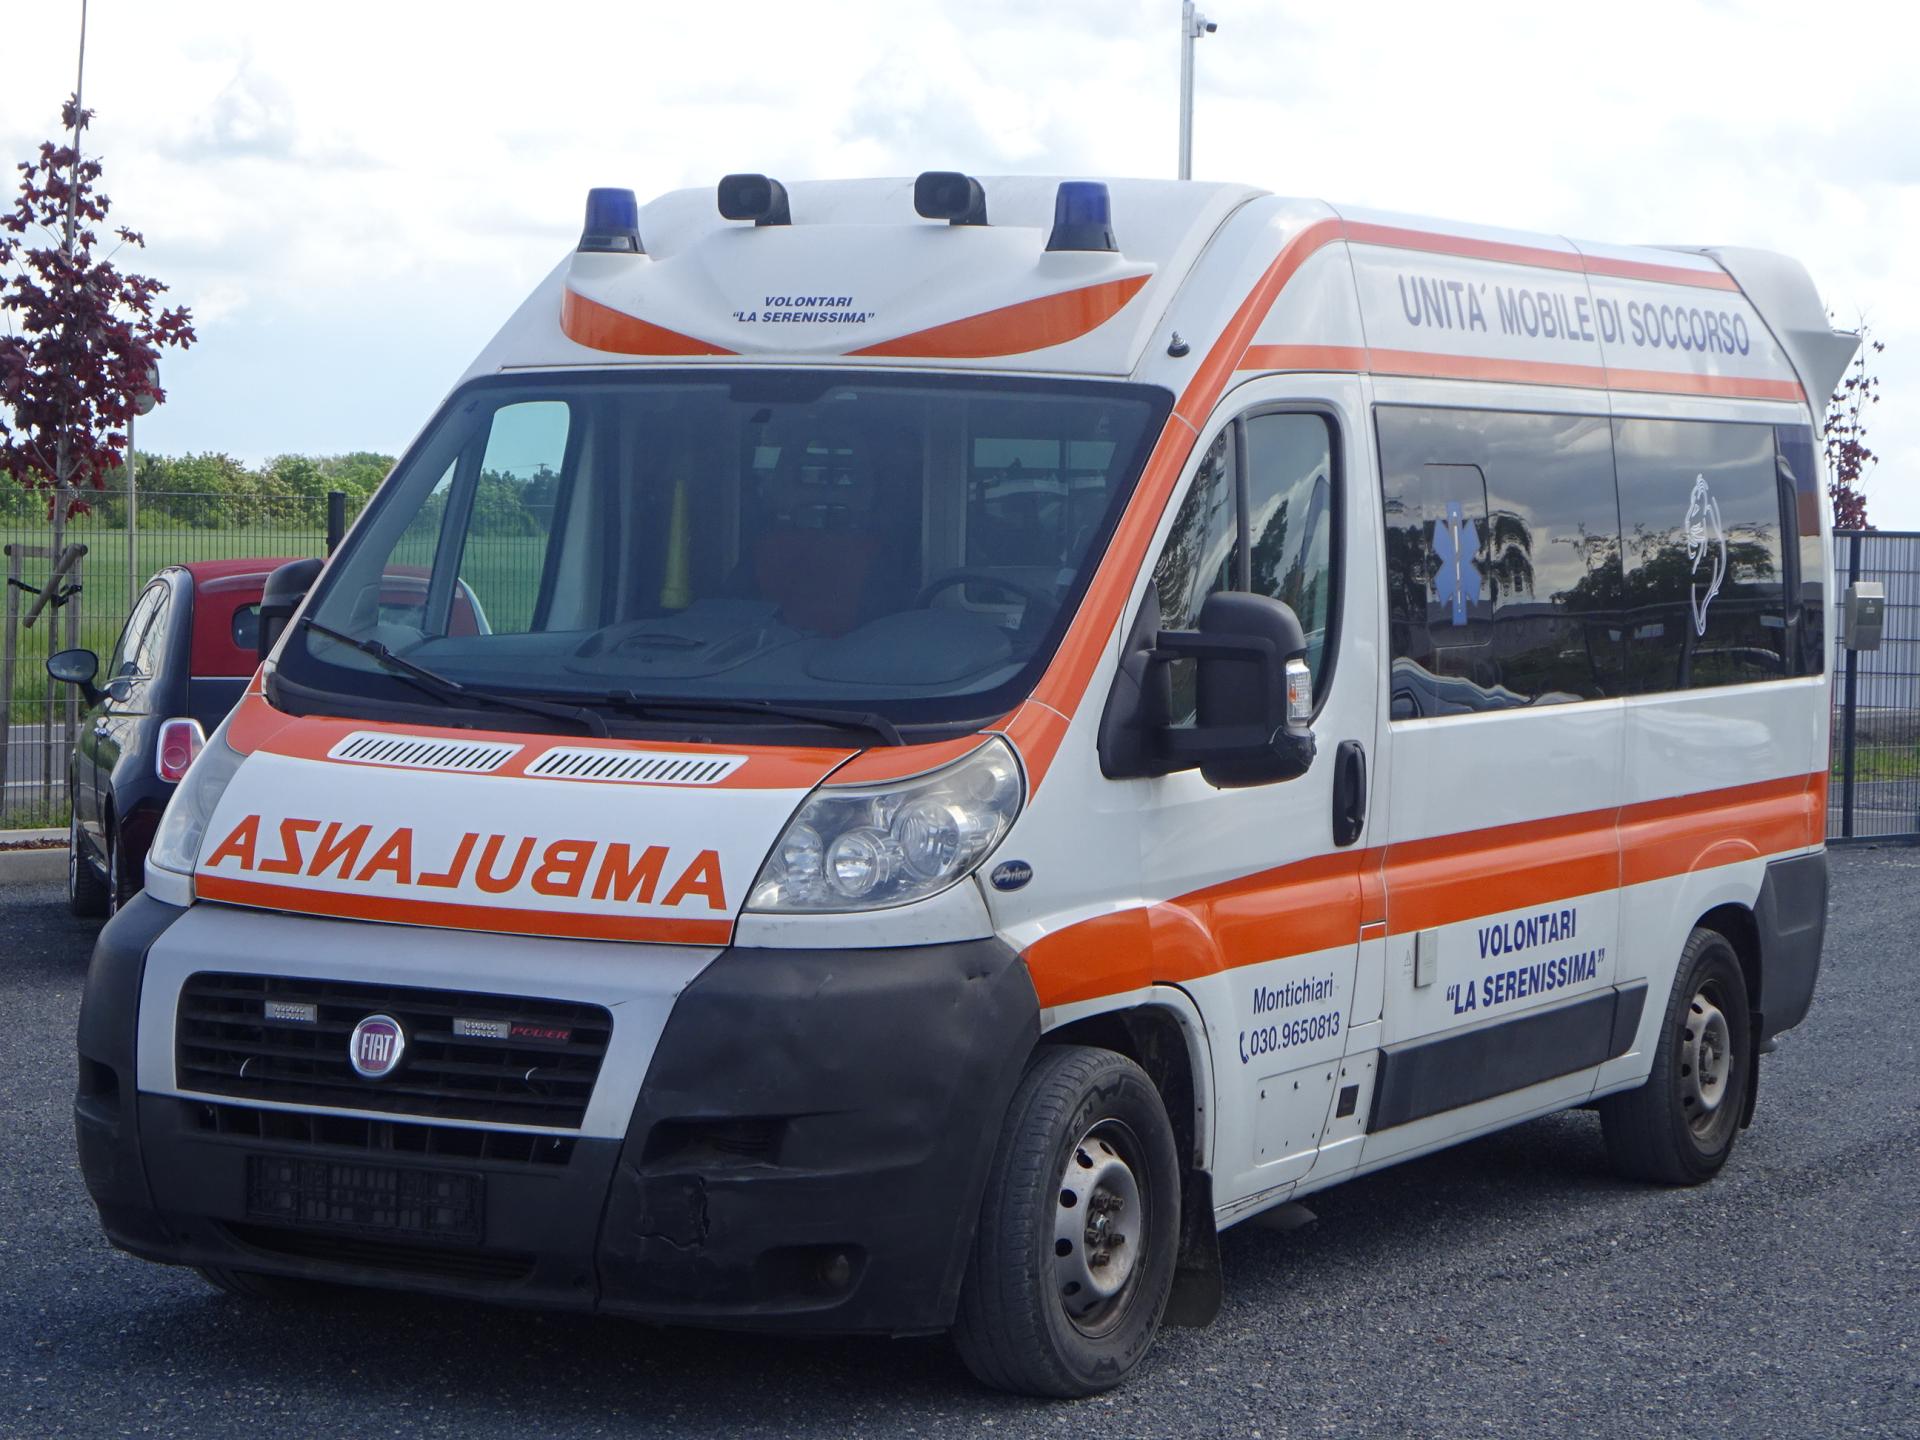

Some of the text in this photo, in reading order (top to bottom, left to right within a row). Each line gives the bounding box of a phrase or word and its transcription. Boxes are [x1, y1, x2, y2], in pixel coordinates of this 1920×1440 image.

[764, 296, 853, 307] VOLONTARI
[1495, 286, 1595, 342] MOBILE
[1596, 298, 1626, 345] DI
[1627, 301, 1750, 357] SOCCORSO
[1478, 908, 1577, 959] VOLONTARI
[1253, 972, 1334, 1015] Montichiari
[360, 1032, 395, 1063] FIAT
[511, 1027, 570, 1040] POWER
[1249, 1011, 1341, 1057] 030.9650813
